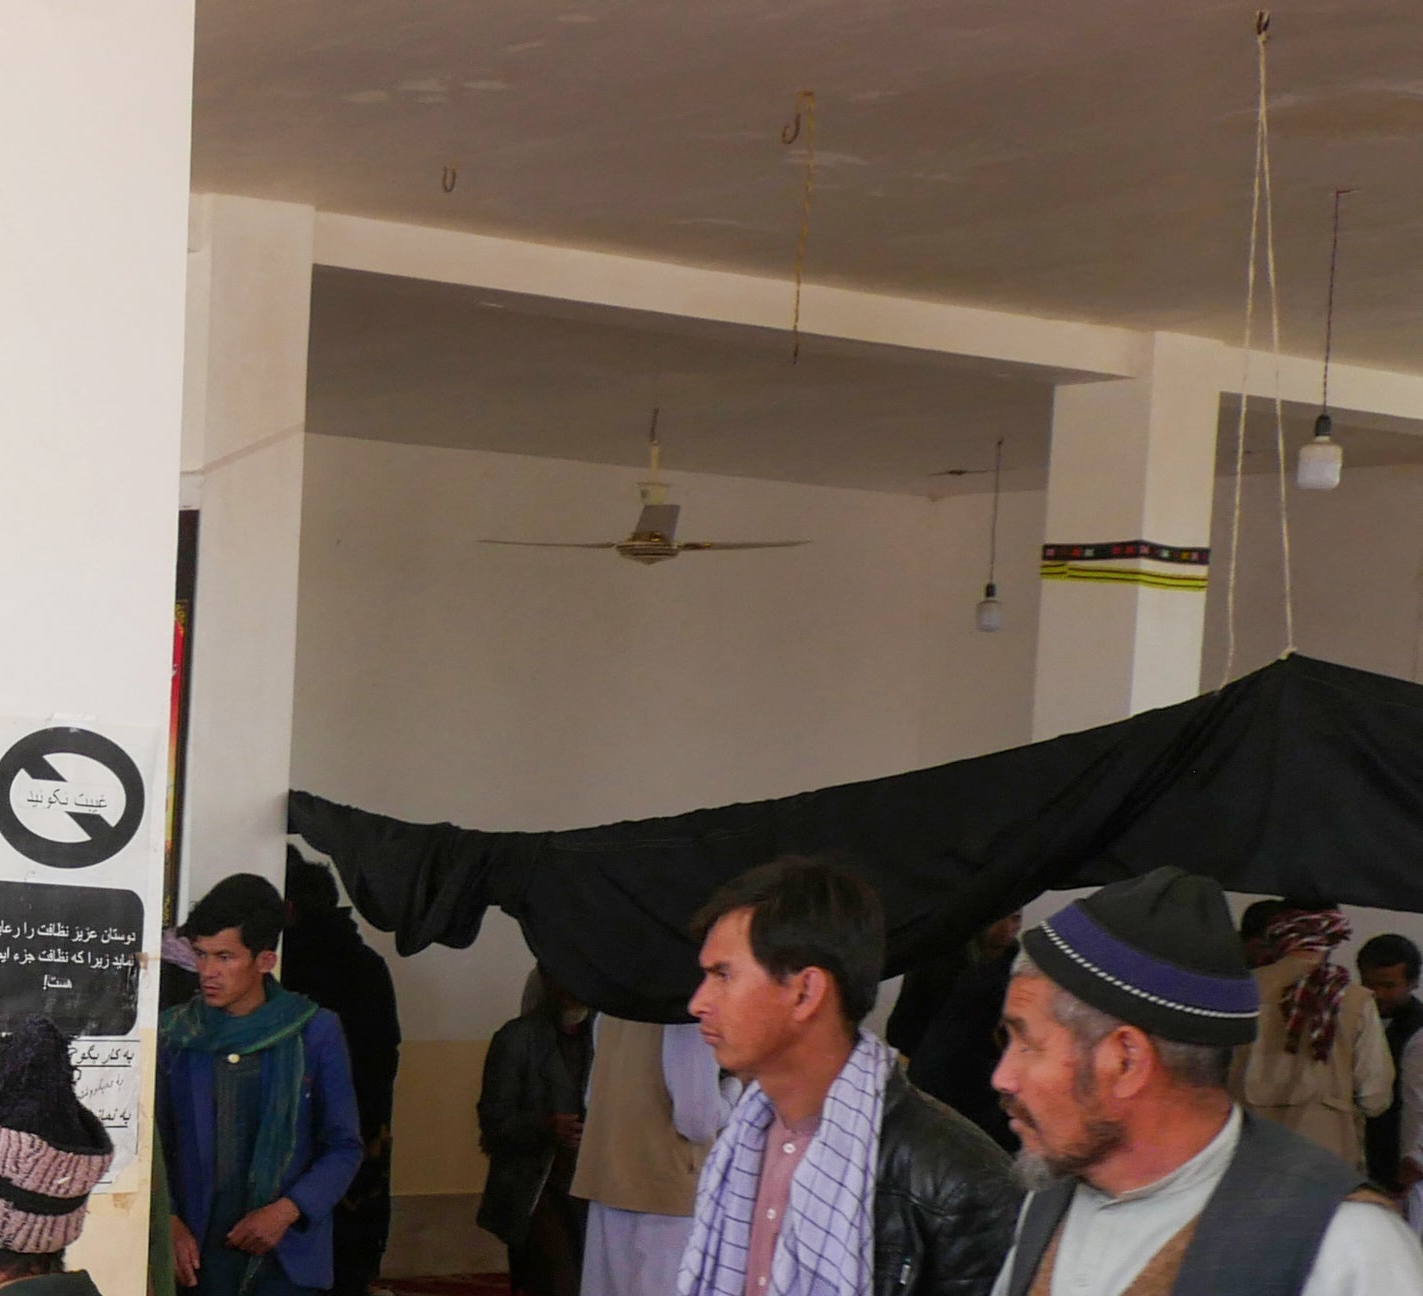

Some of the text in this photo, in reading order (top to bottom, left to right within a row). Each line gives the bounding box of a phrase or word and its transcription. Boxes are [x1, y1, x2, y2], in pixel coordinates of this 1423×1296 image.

[24, 921, 36, 940] را
[37, 921, 70, 939] نظافت
[71, 925, 99, 944] عزیز
[100, 926, 138, 945] دوستان
[37, 949, 70, 965] نظافت
[70, 950, 85, 965] که
[89, 951, 111, 970] زیرا
